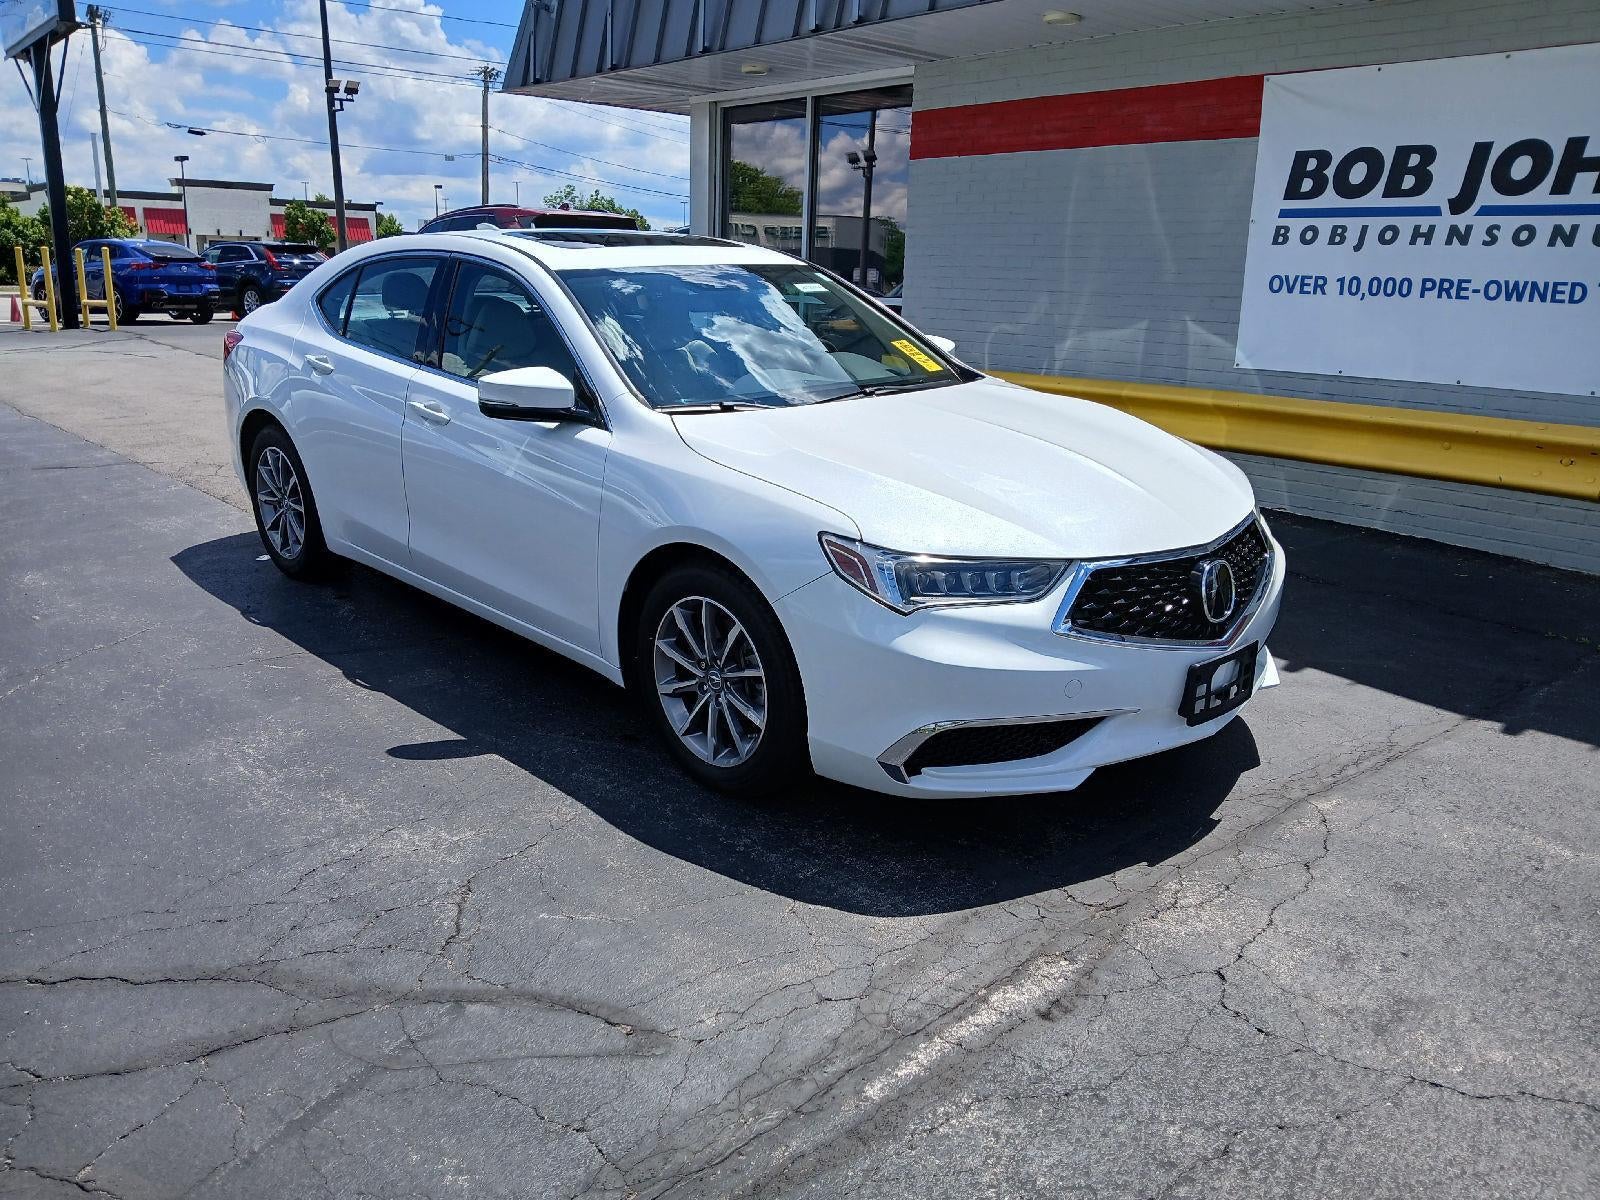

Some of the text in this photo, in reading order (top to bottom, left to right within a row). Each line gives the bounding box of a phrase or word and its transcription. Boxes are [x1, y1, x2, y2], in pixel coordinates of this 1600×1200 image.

[1283, 144, 1438, 201] BOB
[1268, 274, 1328, 296] OVER
[1336, 275, 1413, 301] 10,000
[1419, 277, 1588, 305] PRE-OWNED
